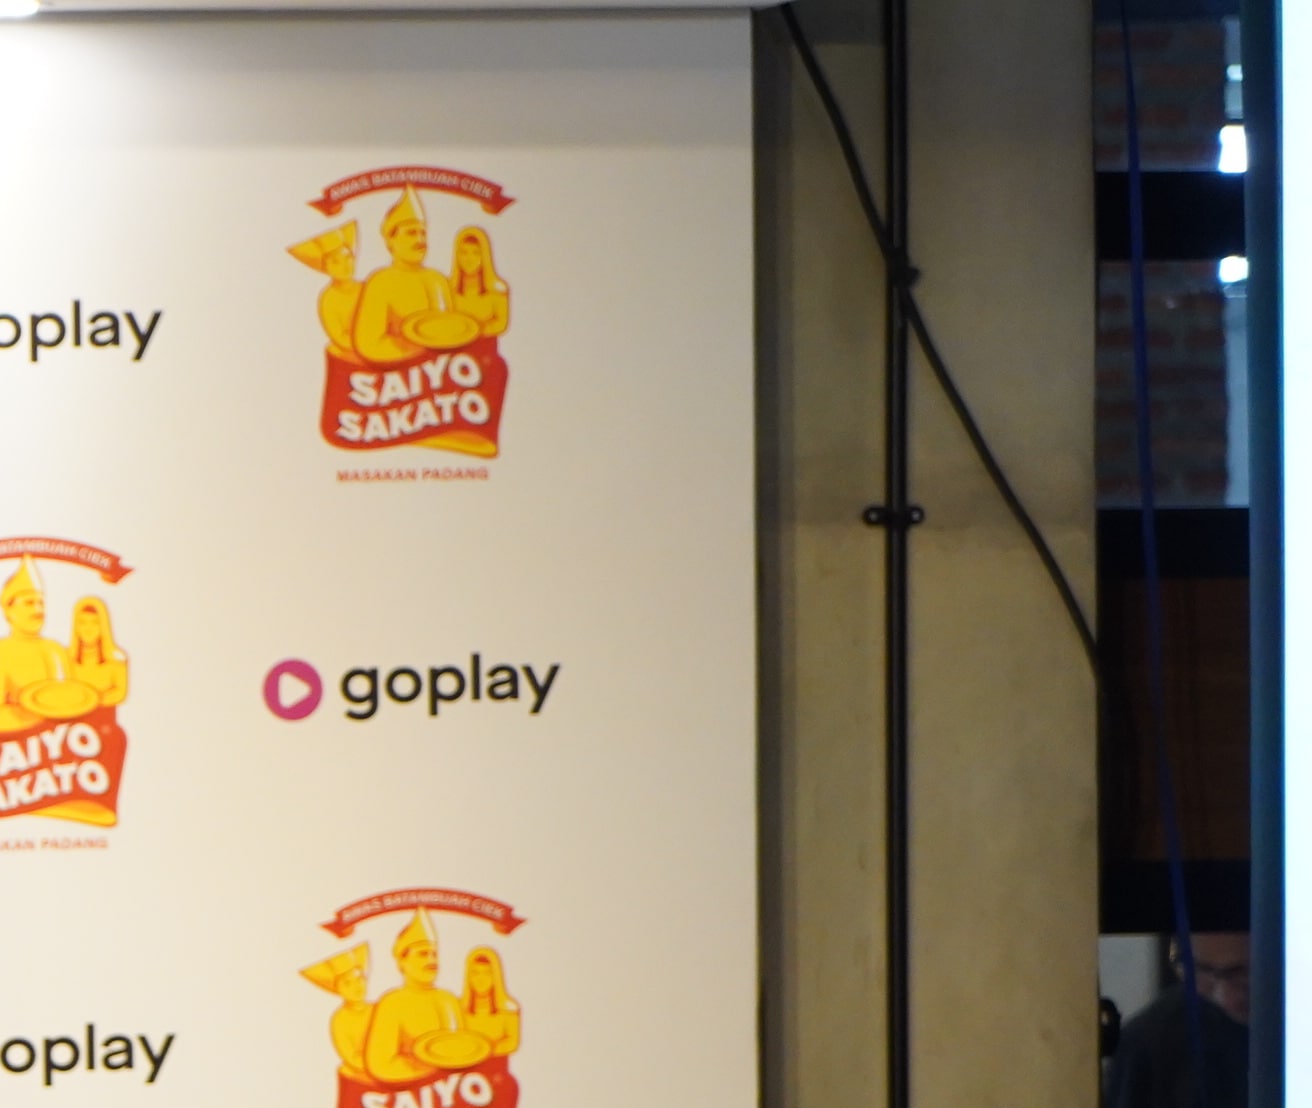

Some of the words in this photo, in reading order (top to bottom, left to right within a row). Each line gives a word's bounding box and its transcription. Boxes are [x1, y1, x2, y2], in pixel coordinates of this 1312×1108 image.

[348, 353, 482, 407] SAIYO
[336, 390, 490, 442] SAKATO
[337, 469, 416, 482] MASAKAN
[422, 467, 489, 479] PADANG
[340, 653, 560, 721] goplay
[41, 836, 108, 849] PADANG
